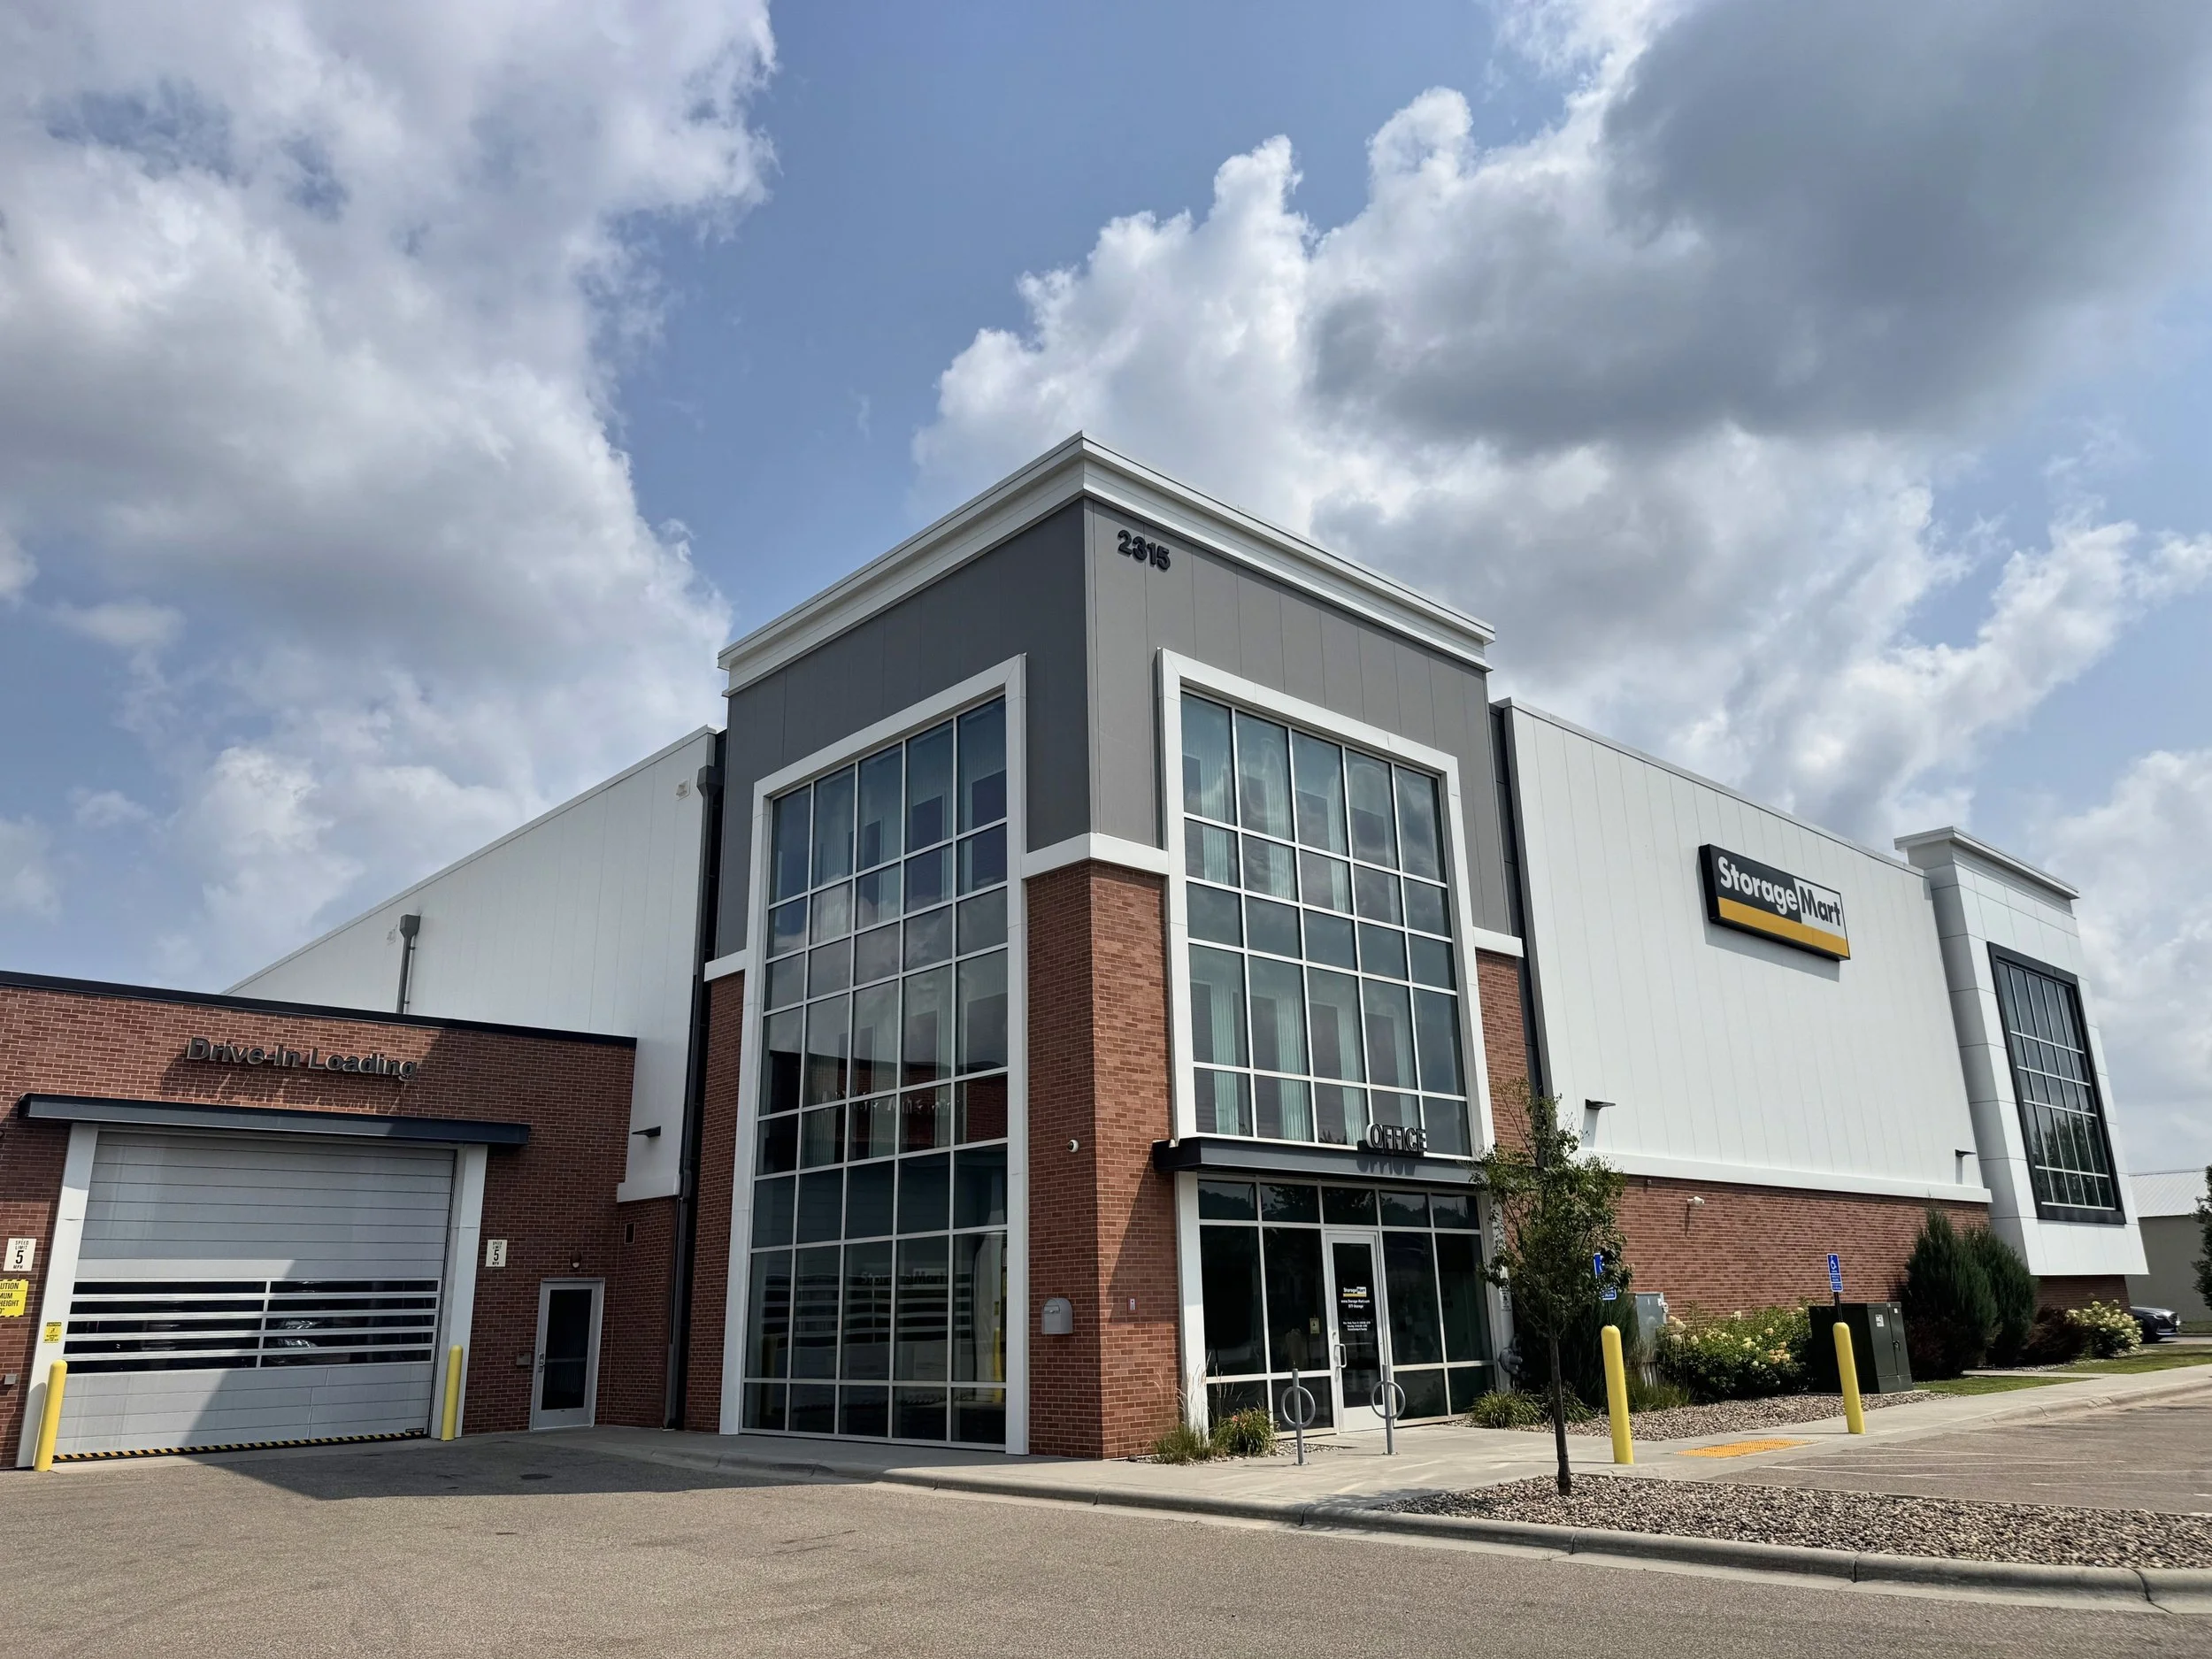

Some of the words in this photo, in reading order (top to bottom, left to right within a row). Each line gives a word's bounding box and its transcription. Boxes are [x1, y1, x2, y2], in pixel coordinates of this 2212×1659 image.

[1117, 529, 1171, 572] 2315
[186, 1036, 302, 1068] Drive-In
[308, 1048, 418, 1081] Loading
[1367, 1123, 1427, 1152] OFFICE
[15, 1250, 24, 1264] 5
[493, 1249, 500, 1262] 5
